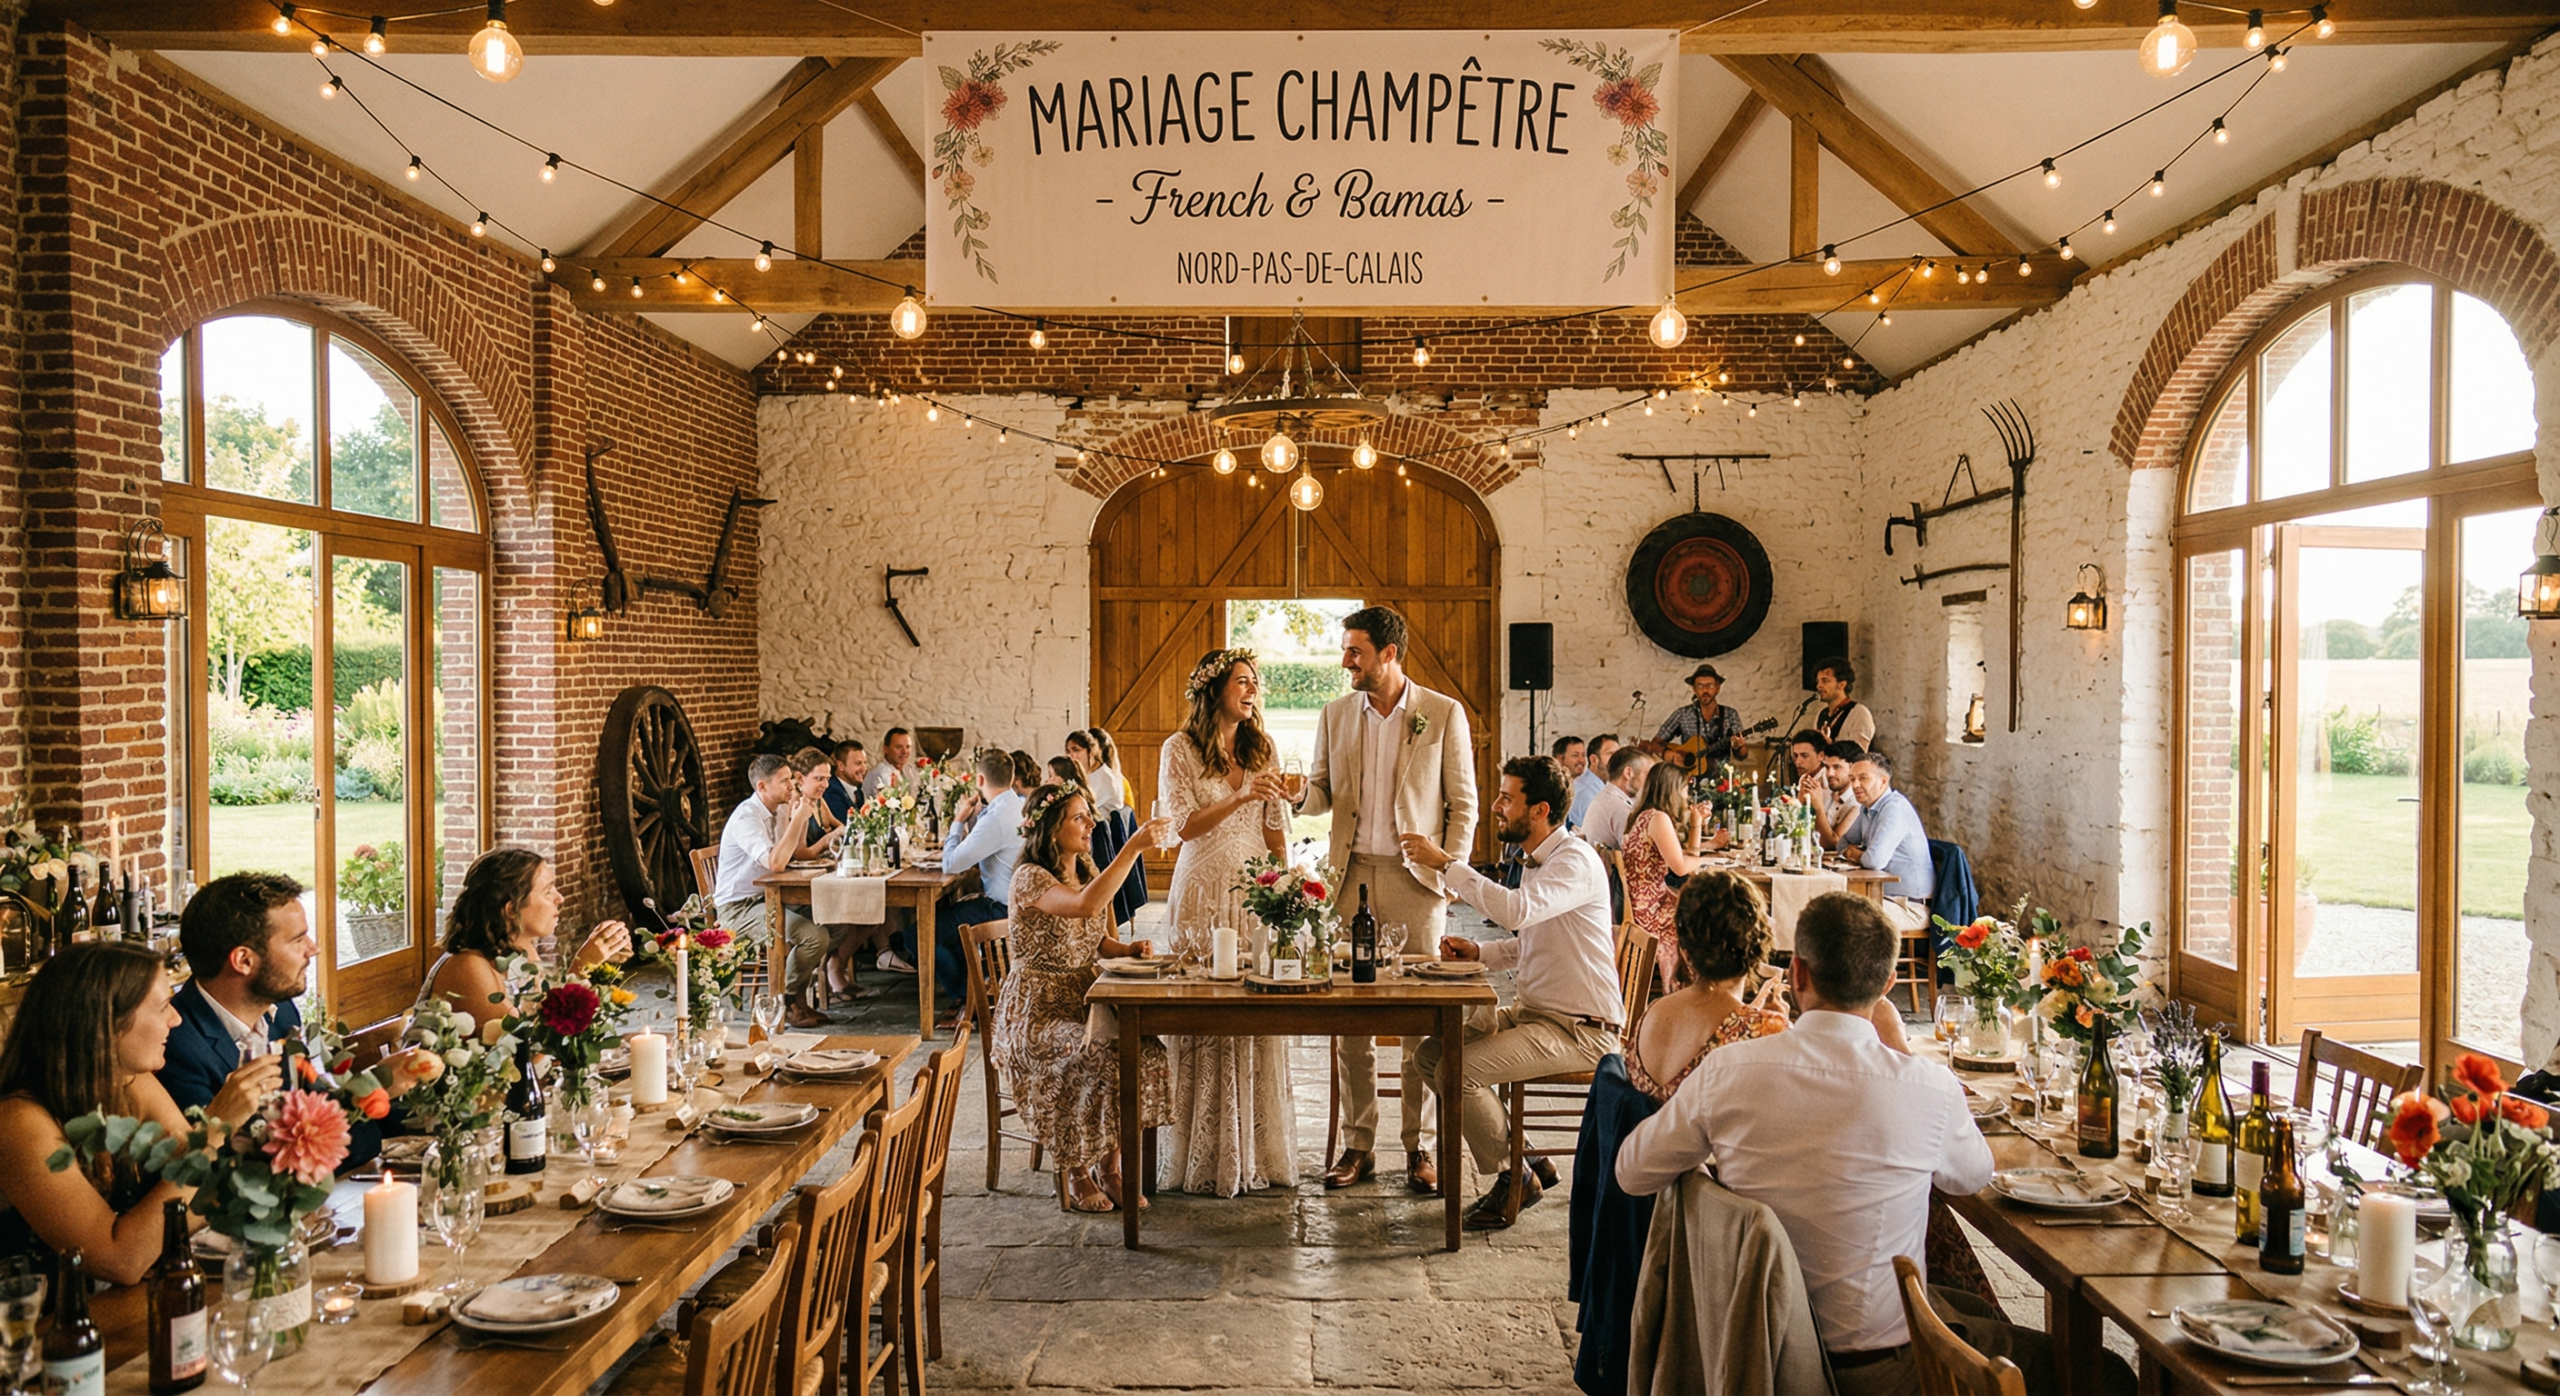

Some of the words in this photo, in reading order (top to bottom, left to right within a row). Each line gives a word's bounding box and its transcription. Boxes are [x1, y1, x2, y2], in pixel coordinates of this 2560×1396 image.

[1027, 71, 1256, 157] MARIAGE
[1276, 55, 1577, 156] CHAMPÊTRE
[1129, 168, 1275, 226] French
[1285, 171, 1321, 220] &
[1333, 167, 1474, 220] Bamas
[1176, 251, 1424, 286] NORD-PAS-DE-CALAIS
